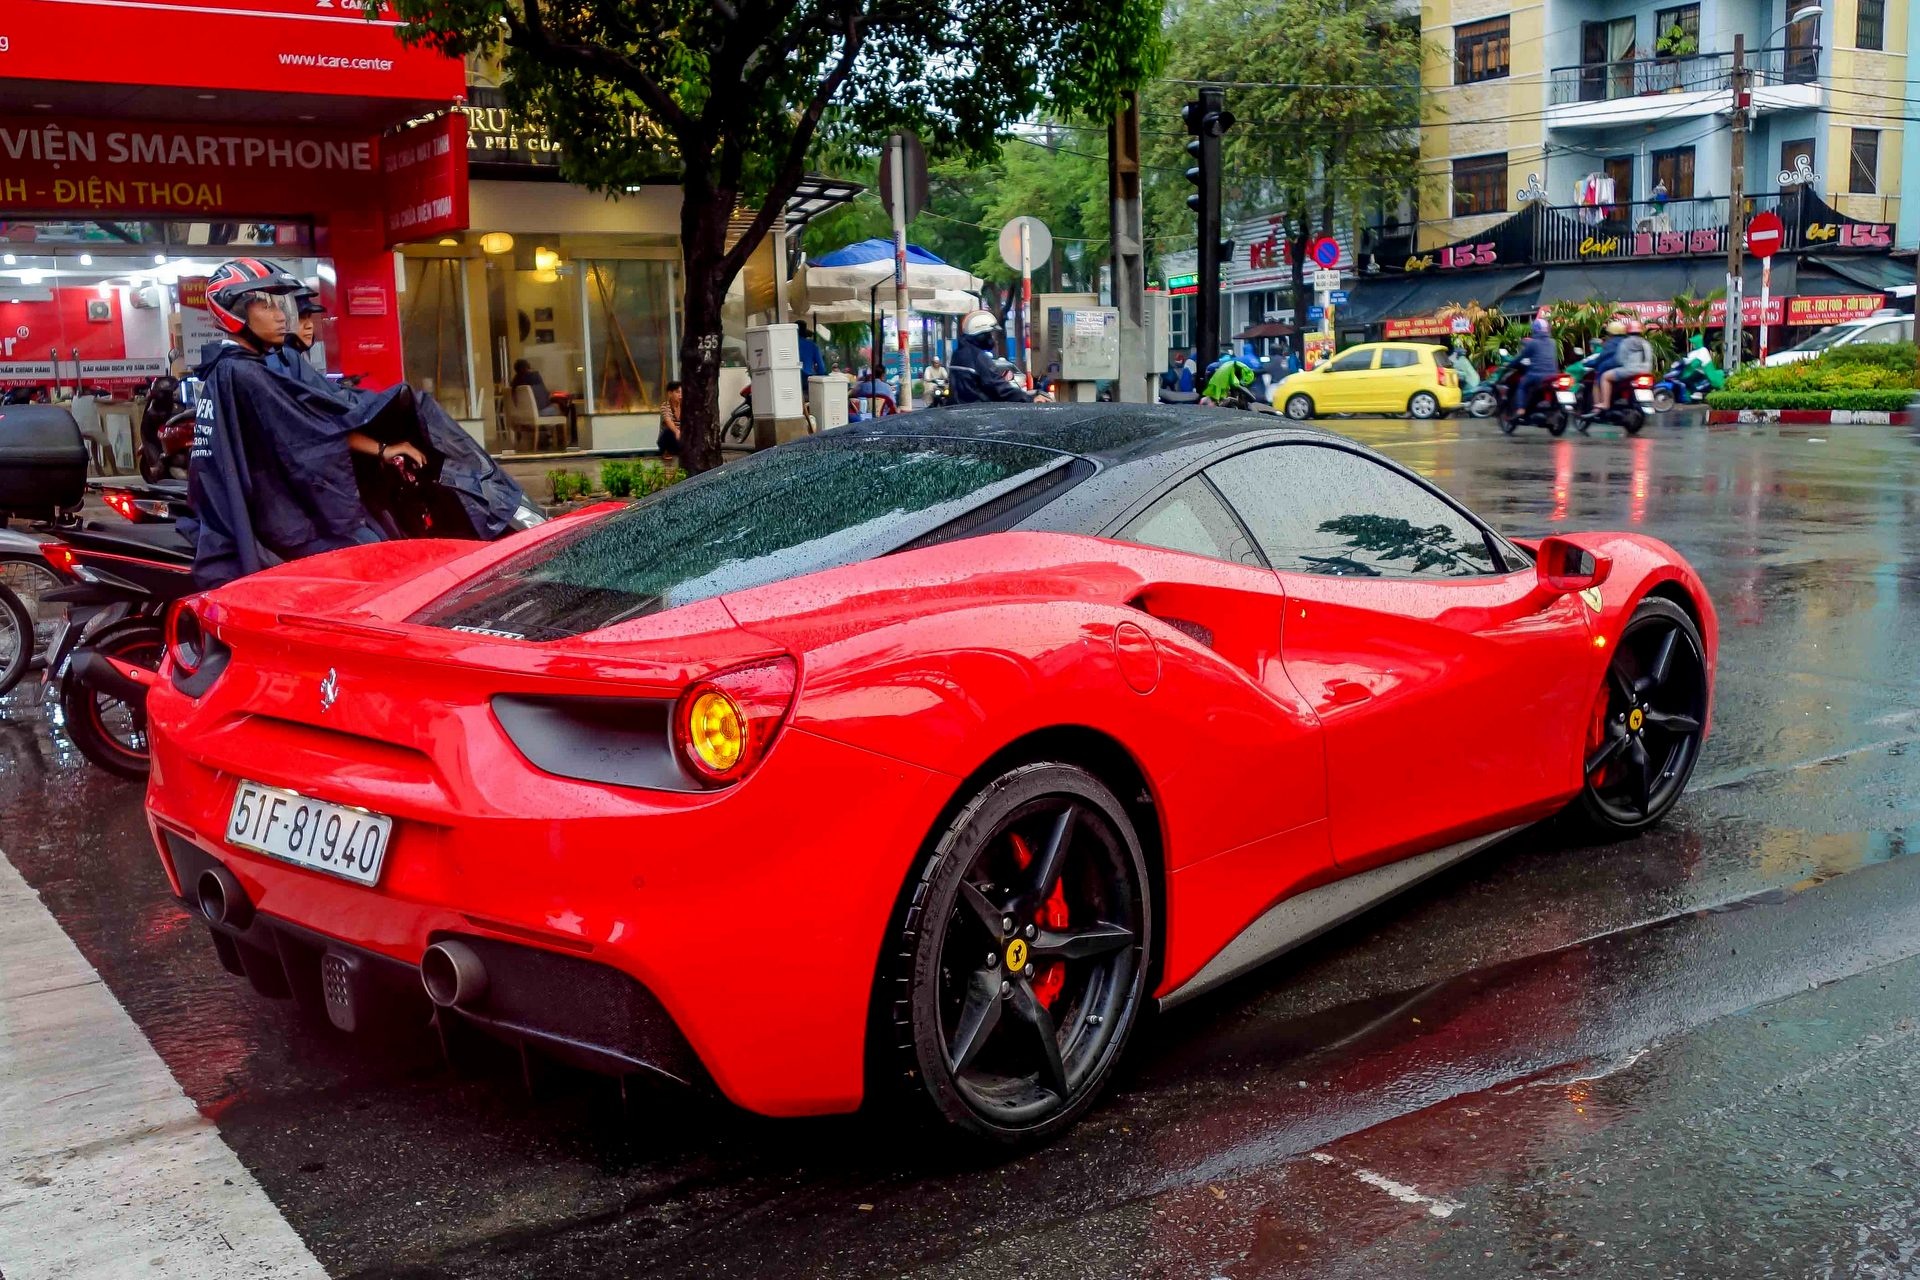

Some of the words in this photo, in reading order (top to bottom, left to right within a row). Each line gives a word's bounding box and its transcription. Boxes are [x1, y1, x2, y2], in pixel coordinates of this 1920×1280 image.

[278, 53, 394, 71] www.icare.center
[0, 123, 97, 169] VIỆN
[106, 132, 373, 171] SMARTPHONE
[466, 131, 477, 149] À
[53, 176, 126, 209] ĐIỆN
[131, 181, 223, 211] THOẠI
[1632, 228, 1718, 256] 155
[1837, 223, 1894, 247] 155
[1438, 242, 1498, 269] 155
[234, 789, 381, 874] 51F-819.40
